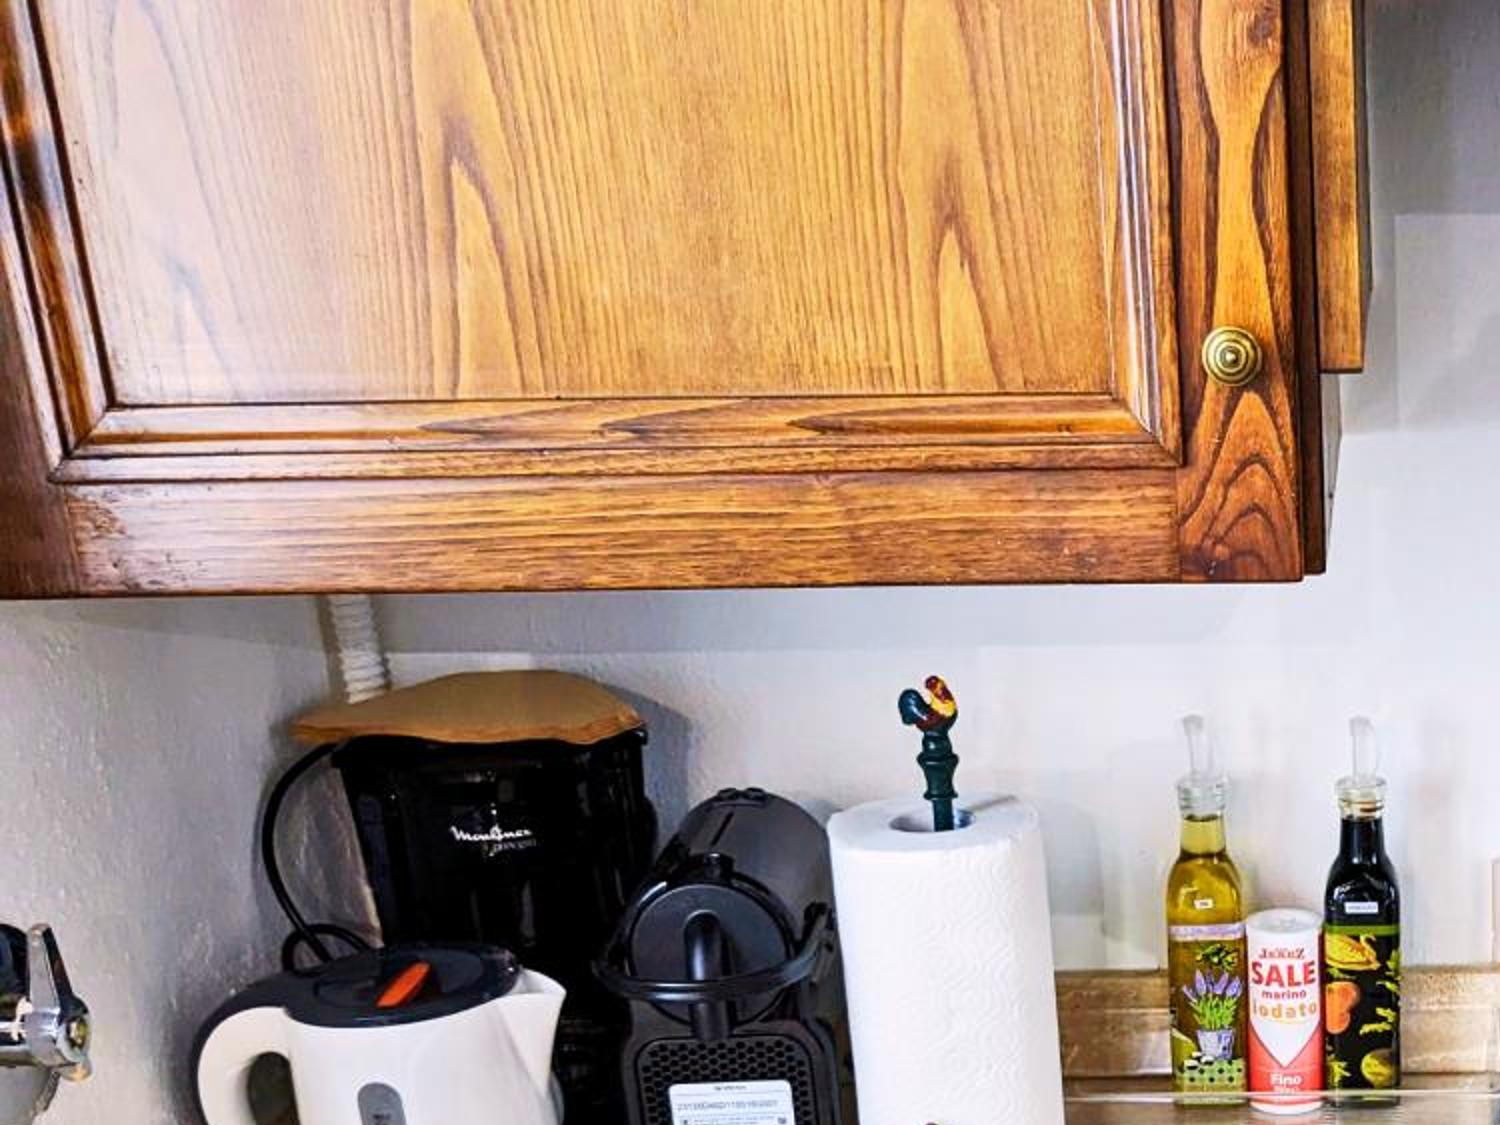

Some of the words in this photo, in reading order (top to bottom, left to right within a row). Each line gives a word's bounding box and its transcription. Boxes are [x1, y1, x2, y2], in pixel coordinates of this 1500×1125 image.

[1252, 961, 1316, 988] SALE
[1262, 990, 1307, 1000] marino
[1271, 1072, 1302, 1086] Fino
